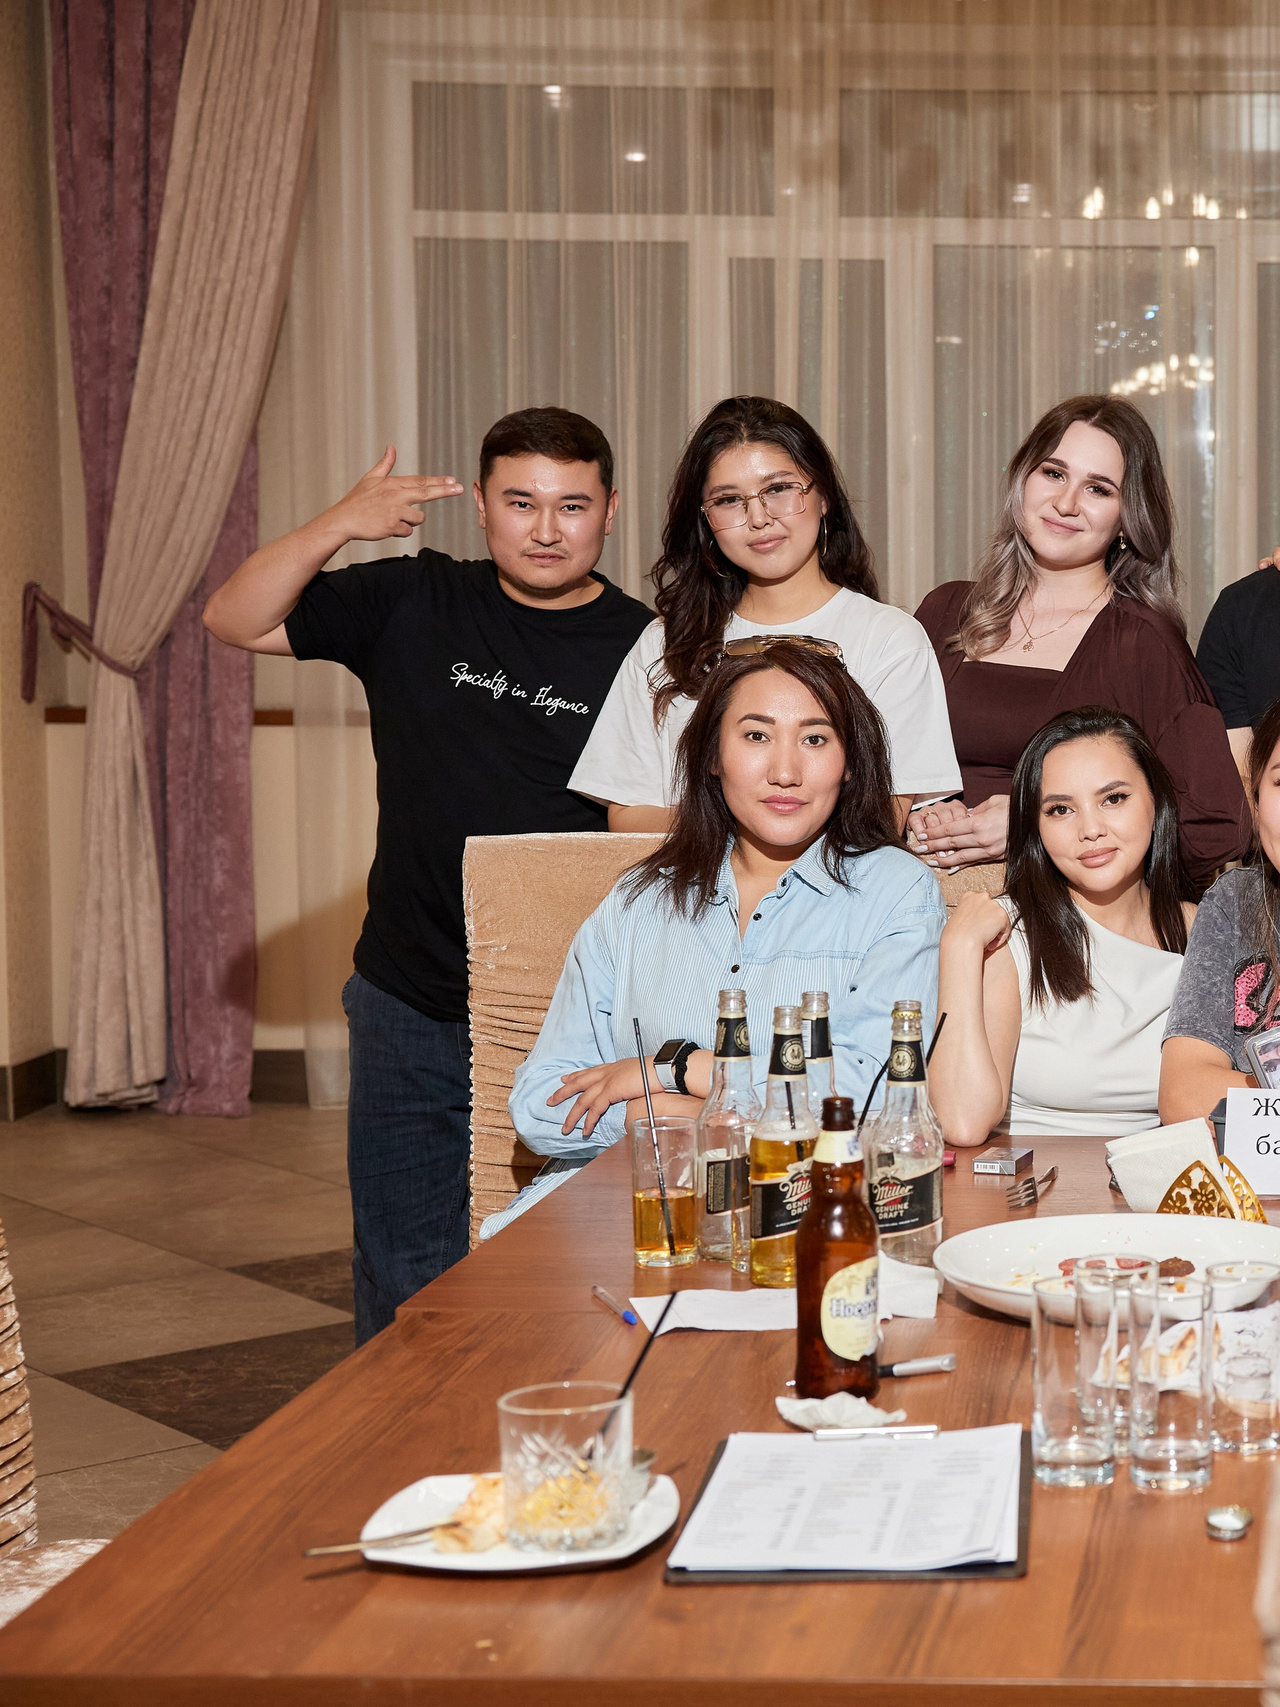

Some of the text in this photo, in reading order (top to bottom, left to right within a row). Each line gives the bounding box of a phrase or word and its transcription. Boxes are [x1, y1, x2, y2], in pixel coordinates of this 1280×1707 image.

[450, 662, 590, 716] Specialty in Elegance
[872, 1184, 914, 1202] Miller
[875, 1202, 910, 1213] GENUINE
[878, 1210, 905, 1219] DRAFT
